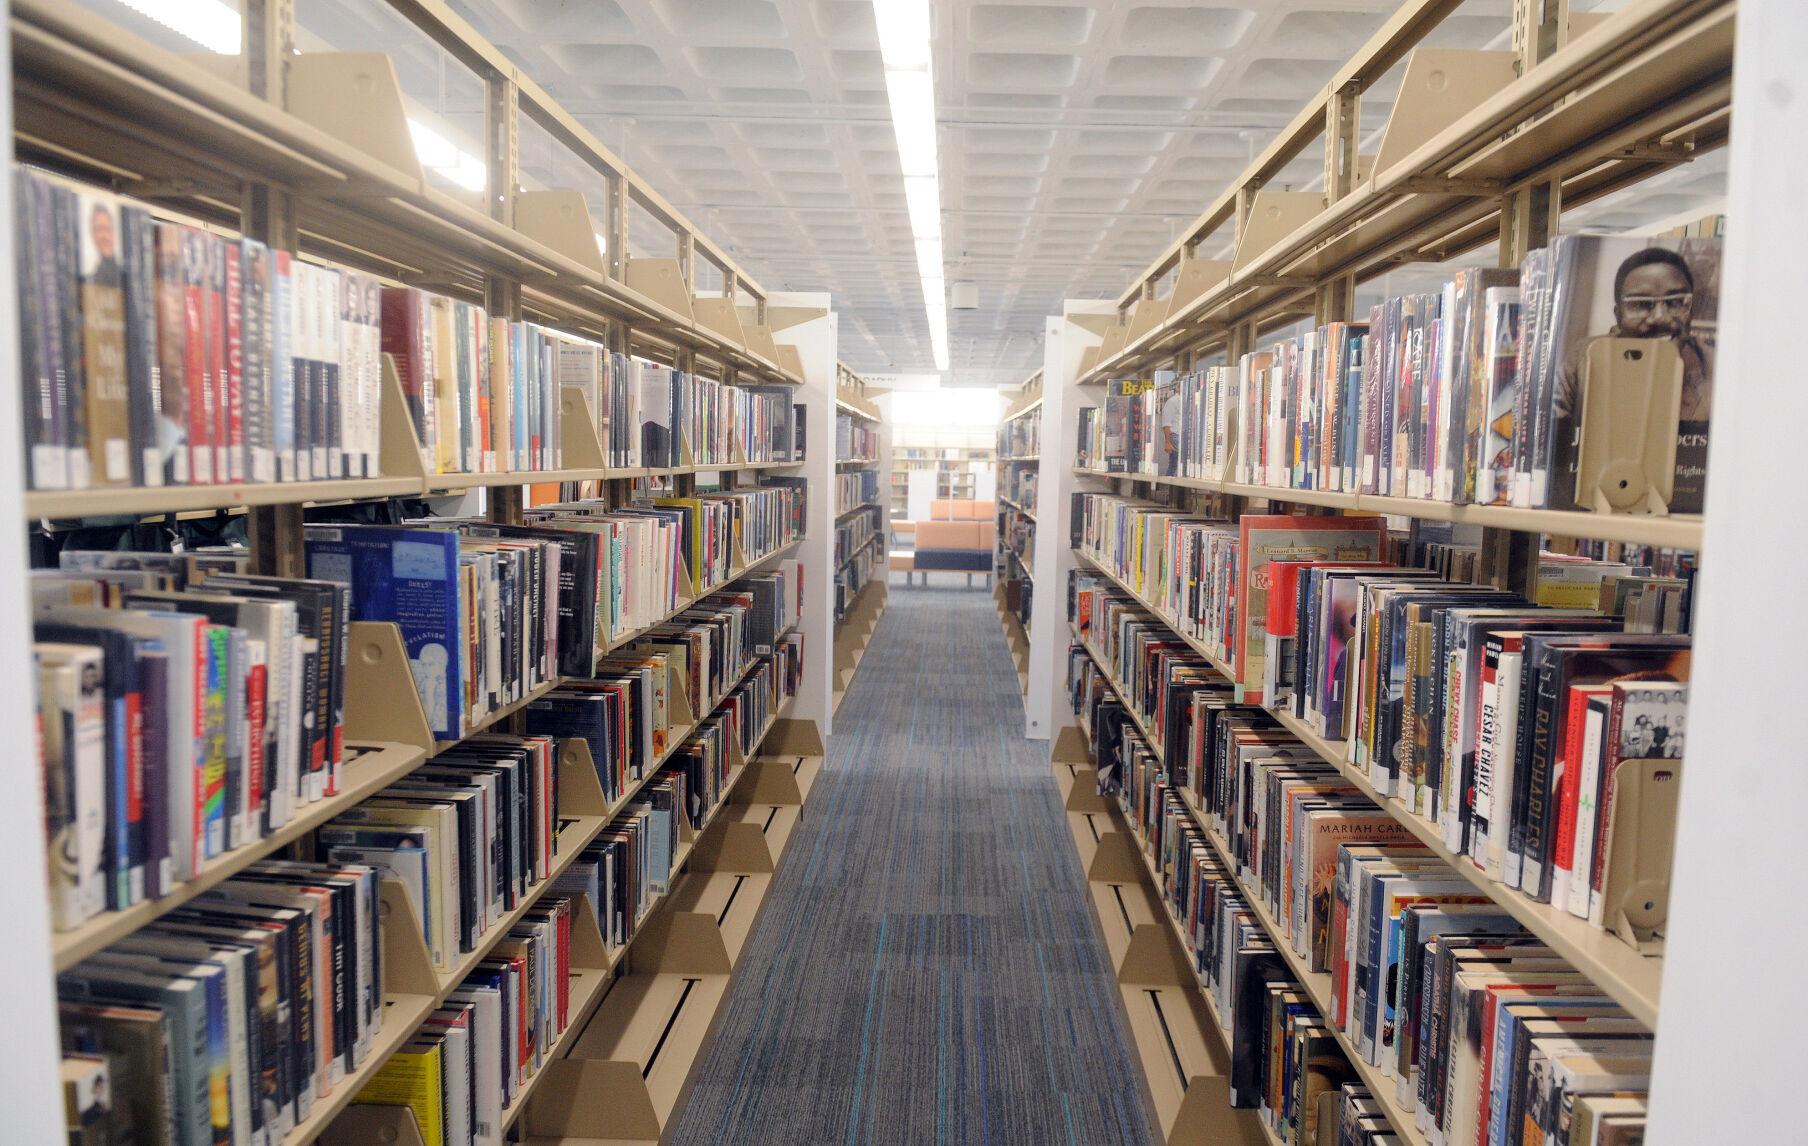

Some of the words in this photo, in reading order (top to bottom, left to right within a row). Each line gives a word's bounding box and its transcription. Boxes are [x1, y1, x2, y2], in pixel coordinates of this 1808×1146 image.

[230, 375, 243, 421] PAY
[248, 353, 261, 456] BERNSTEIN
[342, 590, 351, 623] Charles
[320, 607, 333, 684] RENAISSANCE
[340, 637, 348, 667] Colson
[318, 688, 329, 731] WOMAN
[1483, 704, 1494, 744] CESAR
[1534, 707, 1550, 752] RAY
[1568, 696, 1579, 758] ALEXANDER
[1399, 705, 1408, 769] CHAPMAN
[1515, 725, 1524, 767] HOUSE
[1479, 748, 1492, 798] CHAVEZ
[1527, 755, 1546, 850] CHARLES
[1319, 824, 1372, 834] MARIAH
[298, 923, 309, 978] GENIUS
[1421, 964, 1433, 1025] CHRISTENSEN
[1431, 973, 1441, 1014] AGATHA
[301, 1004, 311, 1043] PLAY
[1429, 1016, 1438, 1060] CHRISTIE
[1450, 1035, 1458, 1080] AGATHA
[1478, 1046, 1487, 1101] CHRIS
[1493, 1018, 1508, 1093] AMERICAN
[1445, 1083, 1455, 1137] CHRISTIE
